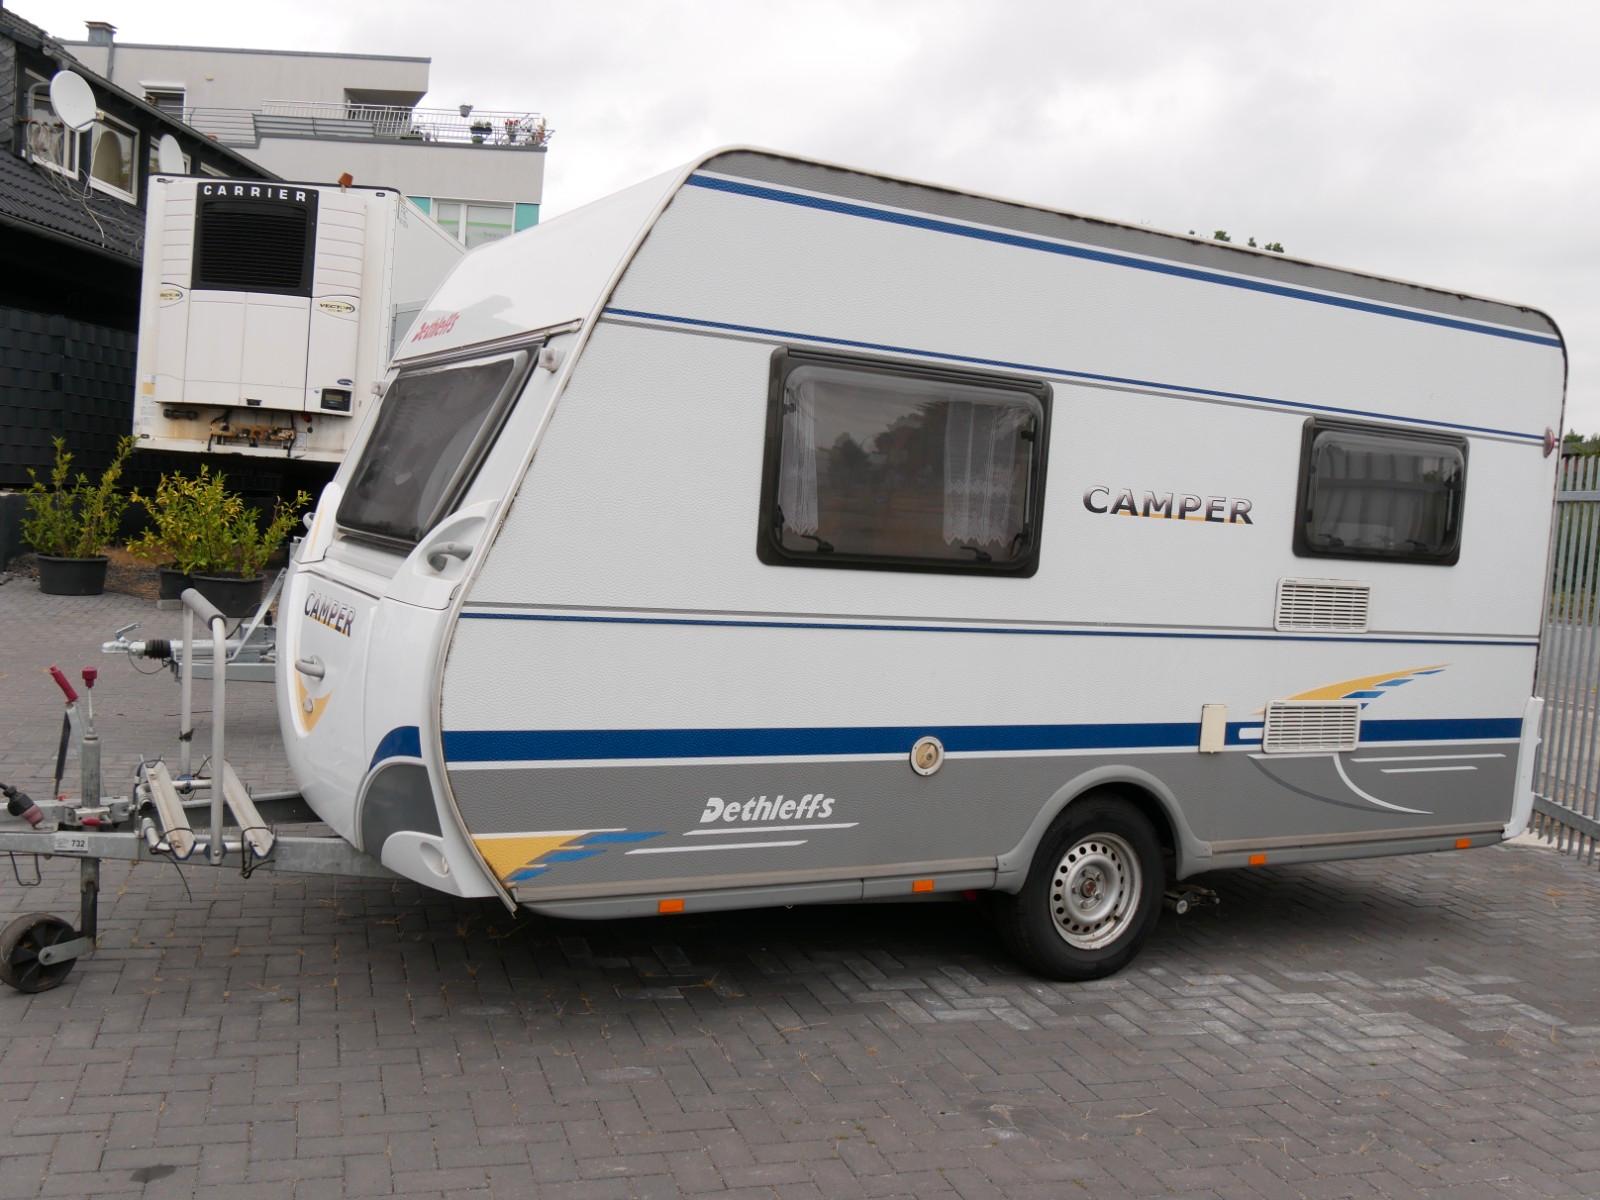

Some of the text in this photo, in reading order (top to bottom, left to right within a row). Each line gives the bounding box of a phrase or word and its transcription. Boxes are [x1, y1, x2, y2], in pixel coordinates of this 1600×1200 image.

[203, 185, 306, 202] CARRIER
[319, 303, 352, 311] VECTOR
[1082, 484, 1253, 525] CAMPER
[304, 592, 356, 637] CAMPER
[700, 793, 836, 823] Dethleffs
[71, 839, 85, 848] 732
